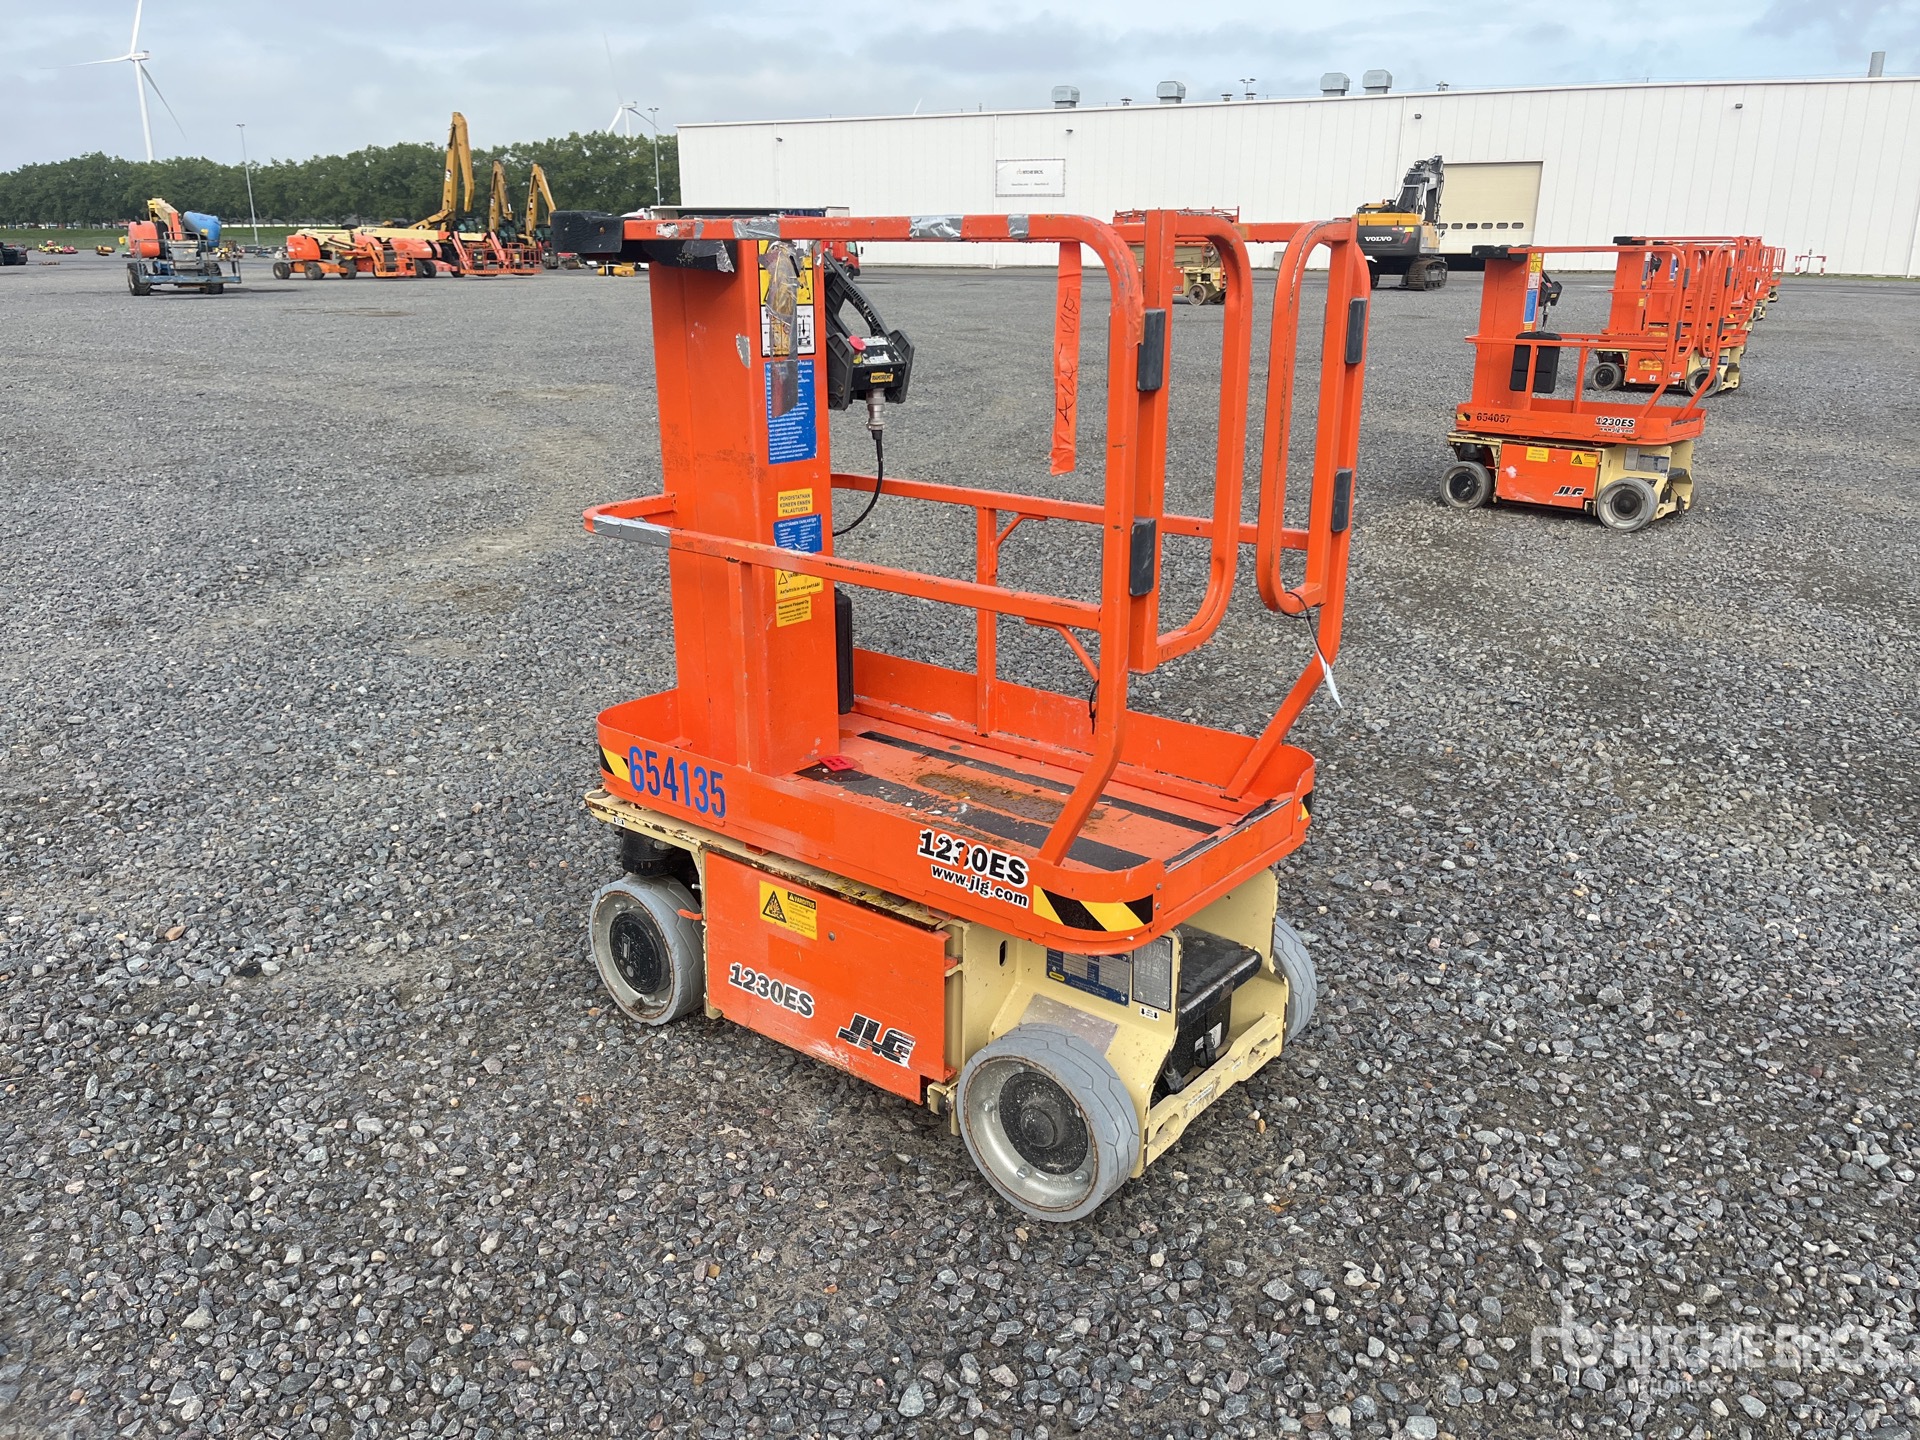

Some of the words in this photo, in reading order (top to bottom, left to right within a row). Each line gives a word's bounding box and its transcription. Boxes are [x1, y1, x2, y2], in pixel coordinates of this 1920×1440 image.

[1476, 412, 1511, 424] 654057
[1595, 416, 1635, 428] 1230ES
[628, 746, 726, 819] 654135
[918, 830, 1029, 889] 1230ES
[930, 863, 1029, 909] www.jlg.com
[728, 964, 815, 1018] 1230ES
[837, 1012, 915, 1066] JLG
